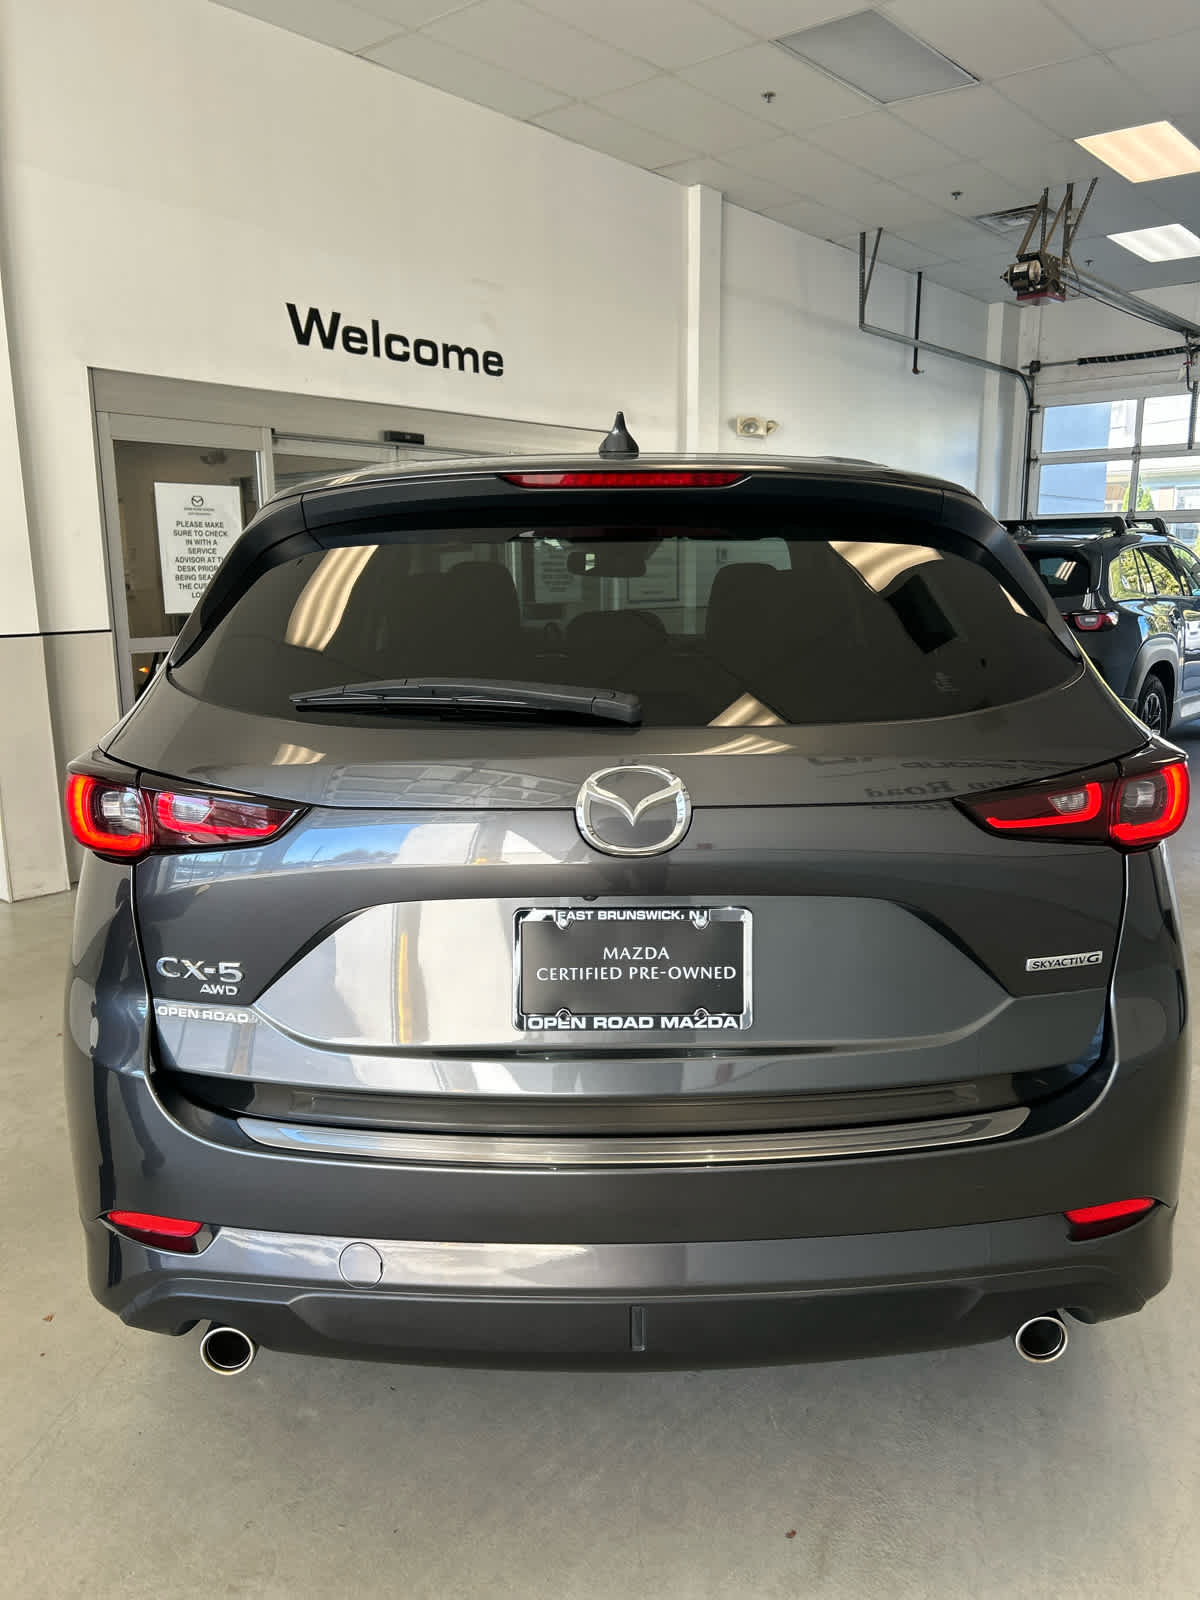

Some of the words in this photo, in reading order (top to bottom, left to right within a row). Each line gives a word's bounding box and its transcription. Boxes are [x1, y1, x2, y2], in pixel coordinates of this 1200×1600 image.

[285, 302, 504, 377] Welcome
[176, 520, 203, 528] PLEASE
[205, 521, 224, 529] MAKE
[173, 529, 192, 537] SURE
[205, 530, 228, 538] CHECK
[188, 547, 217, 555] SERVICE
[557, 910, 594, 921] EAST
[598, 910, 685, 920] BRUNSWICK,
[603, 947, 670, 960] MAZDA
[156, 957, 243, 983] CX-5
[536, 967, 622, 981] CERTIFIED
[629, 966, 736, 980] PRE-OWNED
[200, 983, 238, 996] AWD
[157, 1006, 199, 1019] OPEN
[202, 1010, 249, 1023] ROAD
[528, 1016, 586, 1029] OPEN
[593, 1016, 654, 1029] ROAD
[660, 1016, 738, 1029] MAZDA
